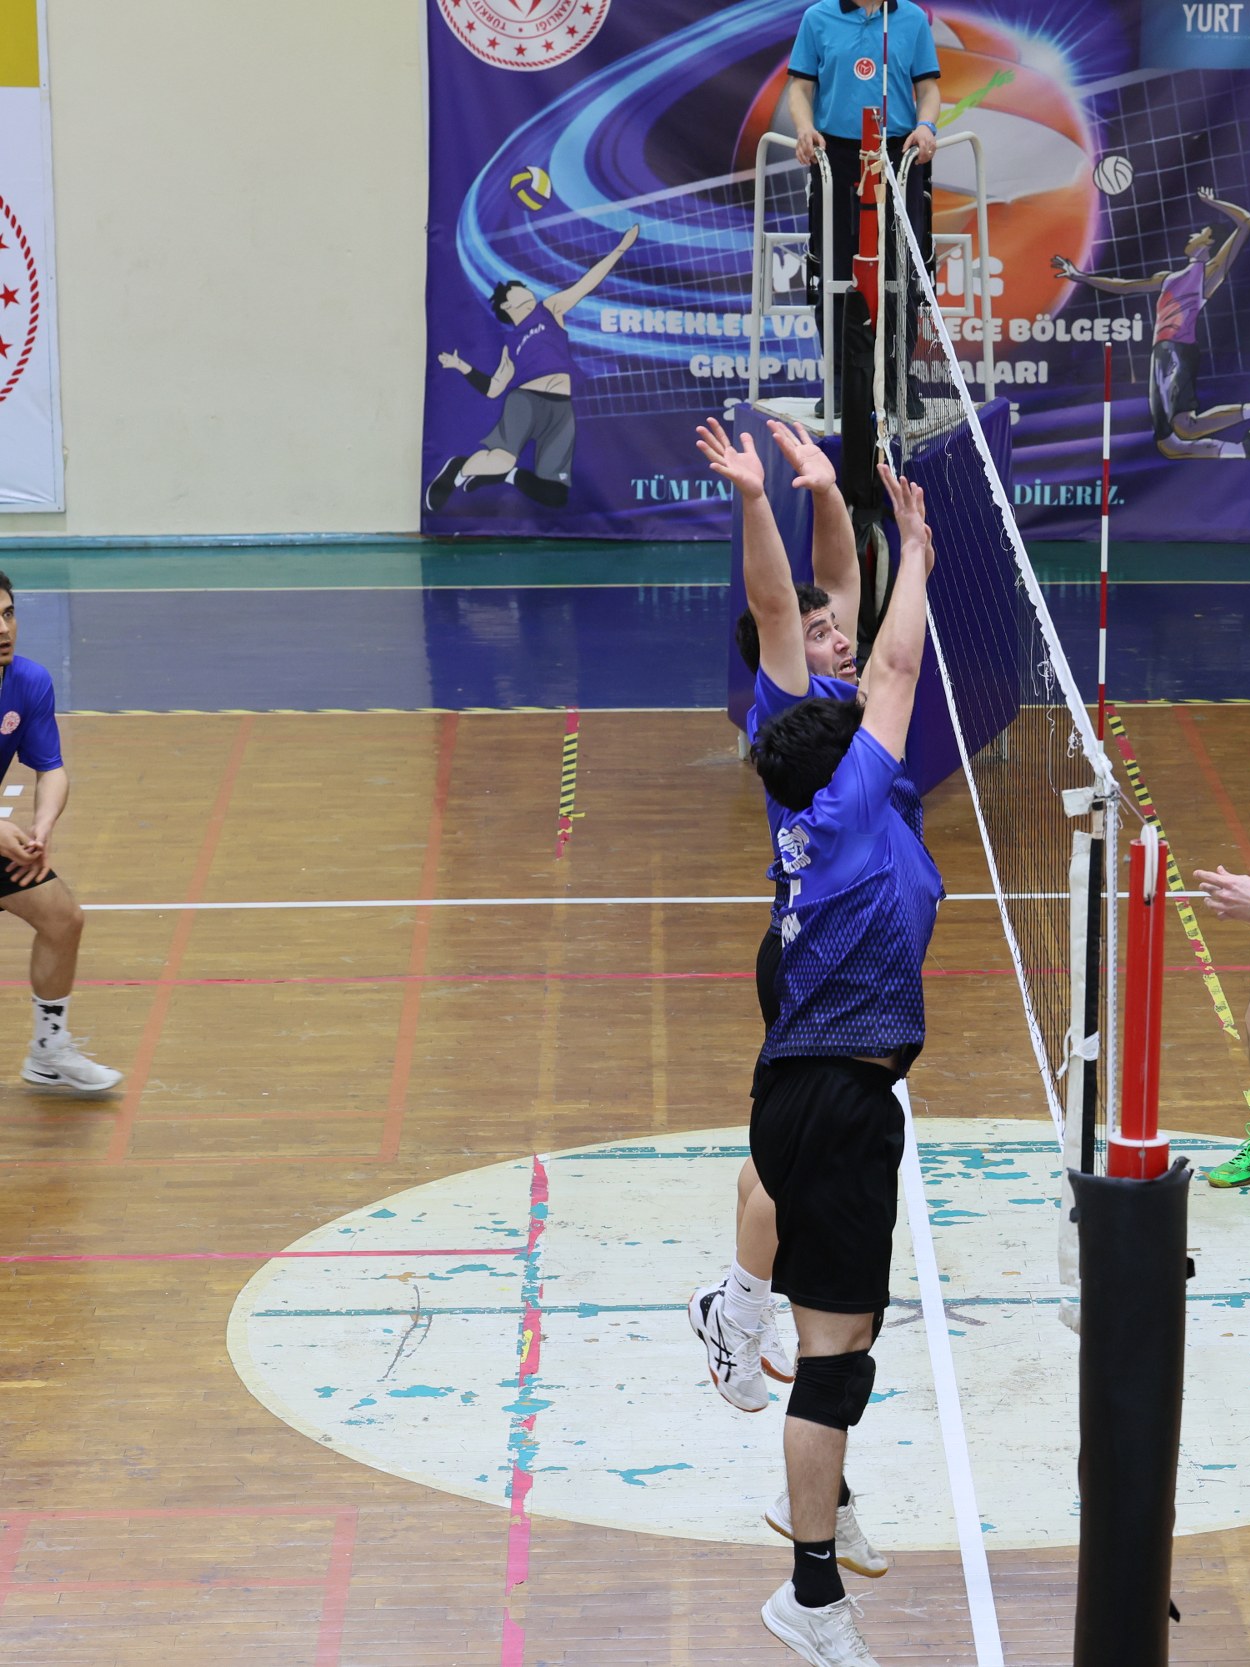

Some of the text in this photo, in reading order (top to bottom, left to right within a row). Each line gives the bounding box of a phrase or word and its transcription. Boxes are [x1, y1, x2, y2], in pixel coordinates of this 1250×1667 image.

[1182, 4, 1244, 32] YURT
[1009, 313, 1143, 342] BÖLGESİ
[631, 474, 689, 500] TÜM
[1014, 479, 1125, 505] DİLERİZ.
